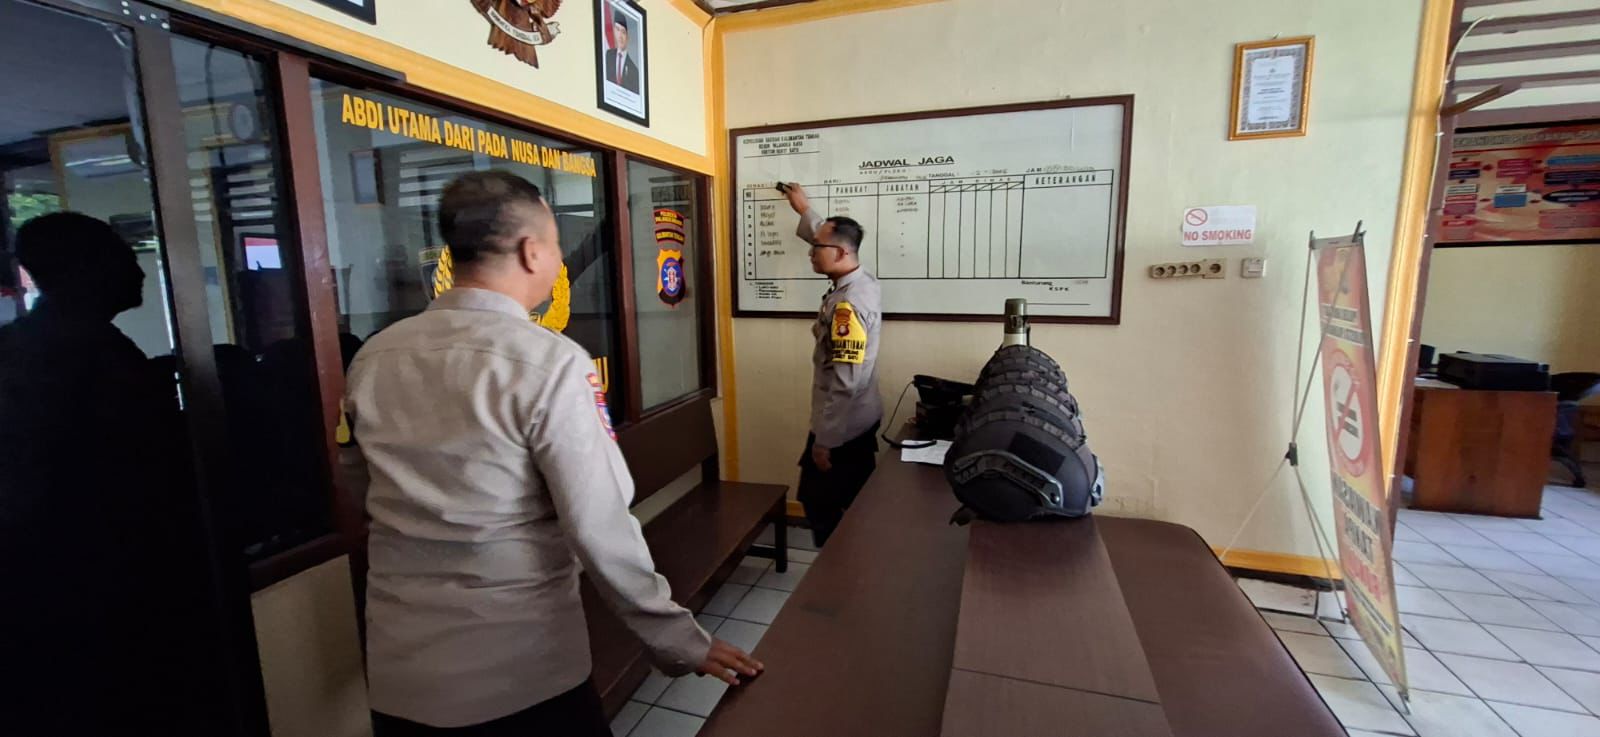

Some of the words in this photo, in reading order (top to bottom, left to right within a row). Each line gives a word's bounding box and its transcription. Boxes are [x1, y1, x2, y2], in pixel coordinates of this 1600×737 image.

[342, 94, 384, 131] ABDI
[387, 105, 442, 144] UTAMA
[443, 120, 475, 151] DARI
[477, 131, 509, 159] PADA
[511, 138, 540, 166] NUSA
[541, 146, 561, 169] DAN
[561, 151, 597, 177] BANGSA
[858, 158, 910, 169] JADWAL
[918, 155, 955, 166] JAGA
[1035, 174, 1097, 186] KETERANGAN
[886, 183, 919, 192] JABATAN
[1183, 231, 1199, 241] NO
[1201, 229, 1252, 241] SMOKING
